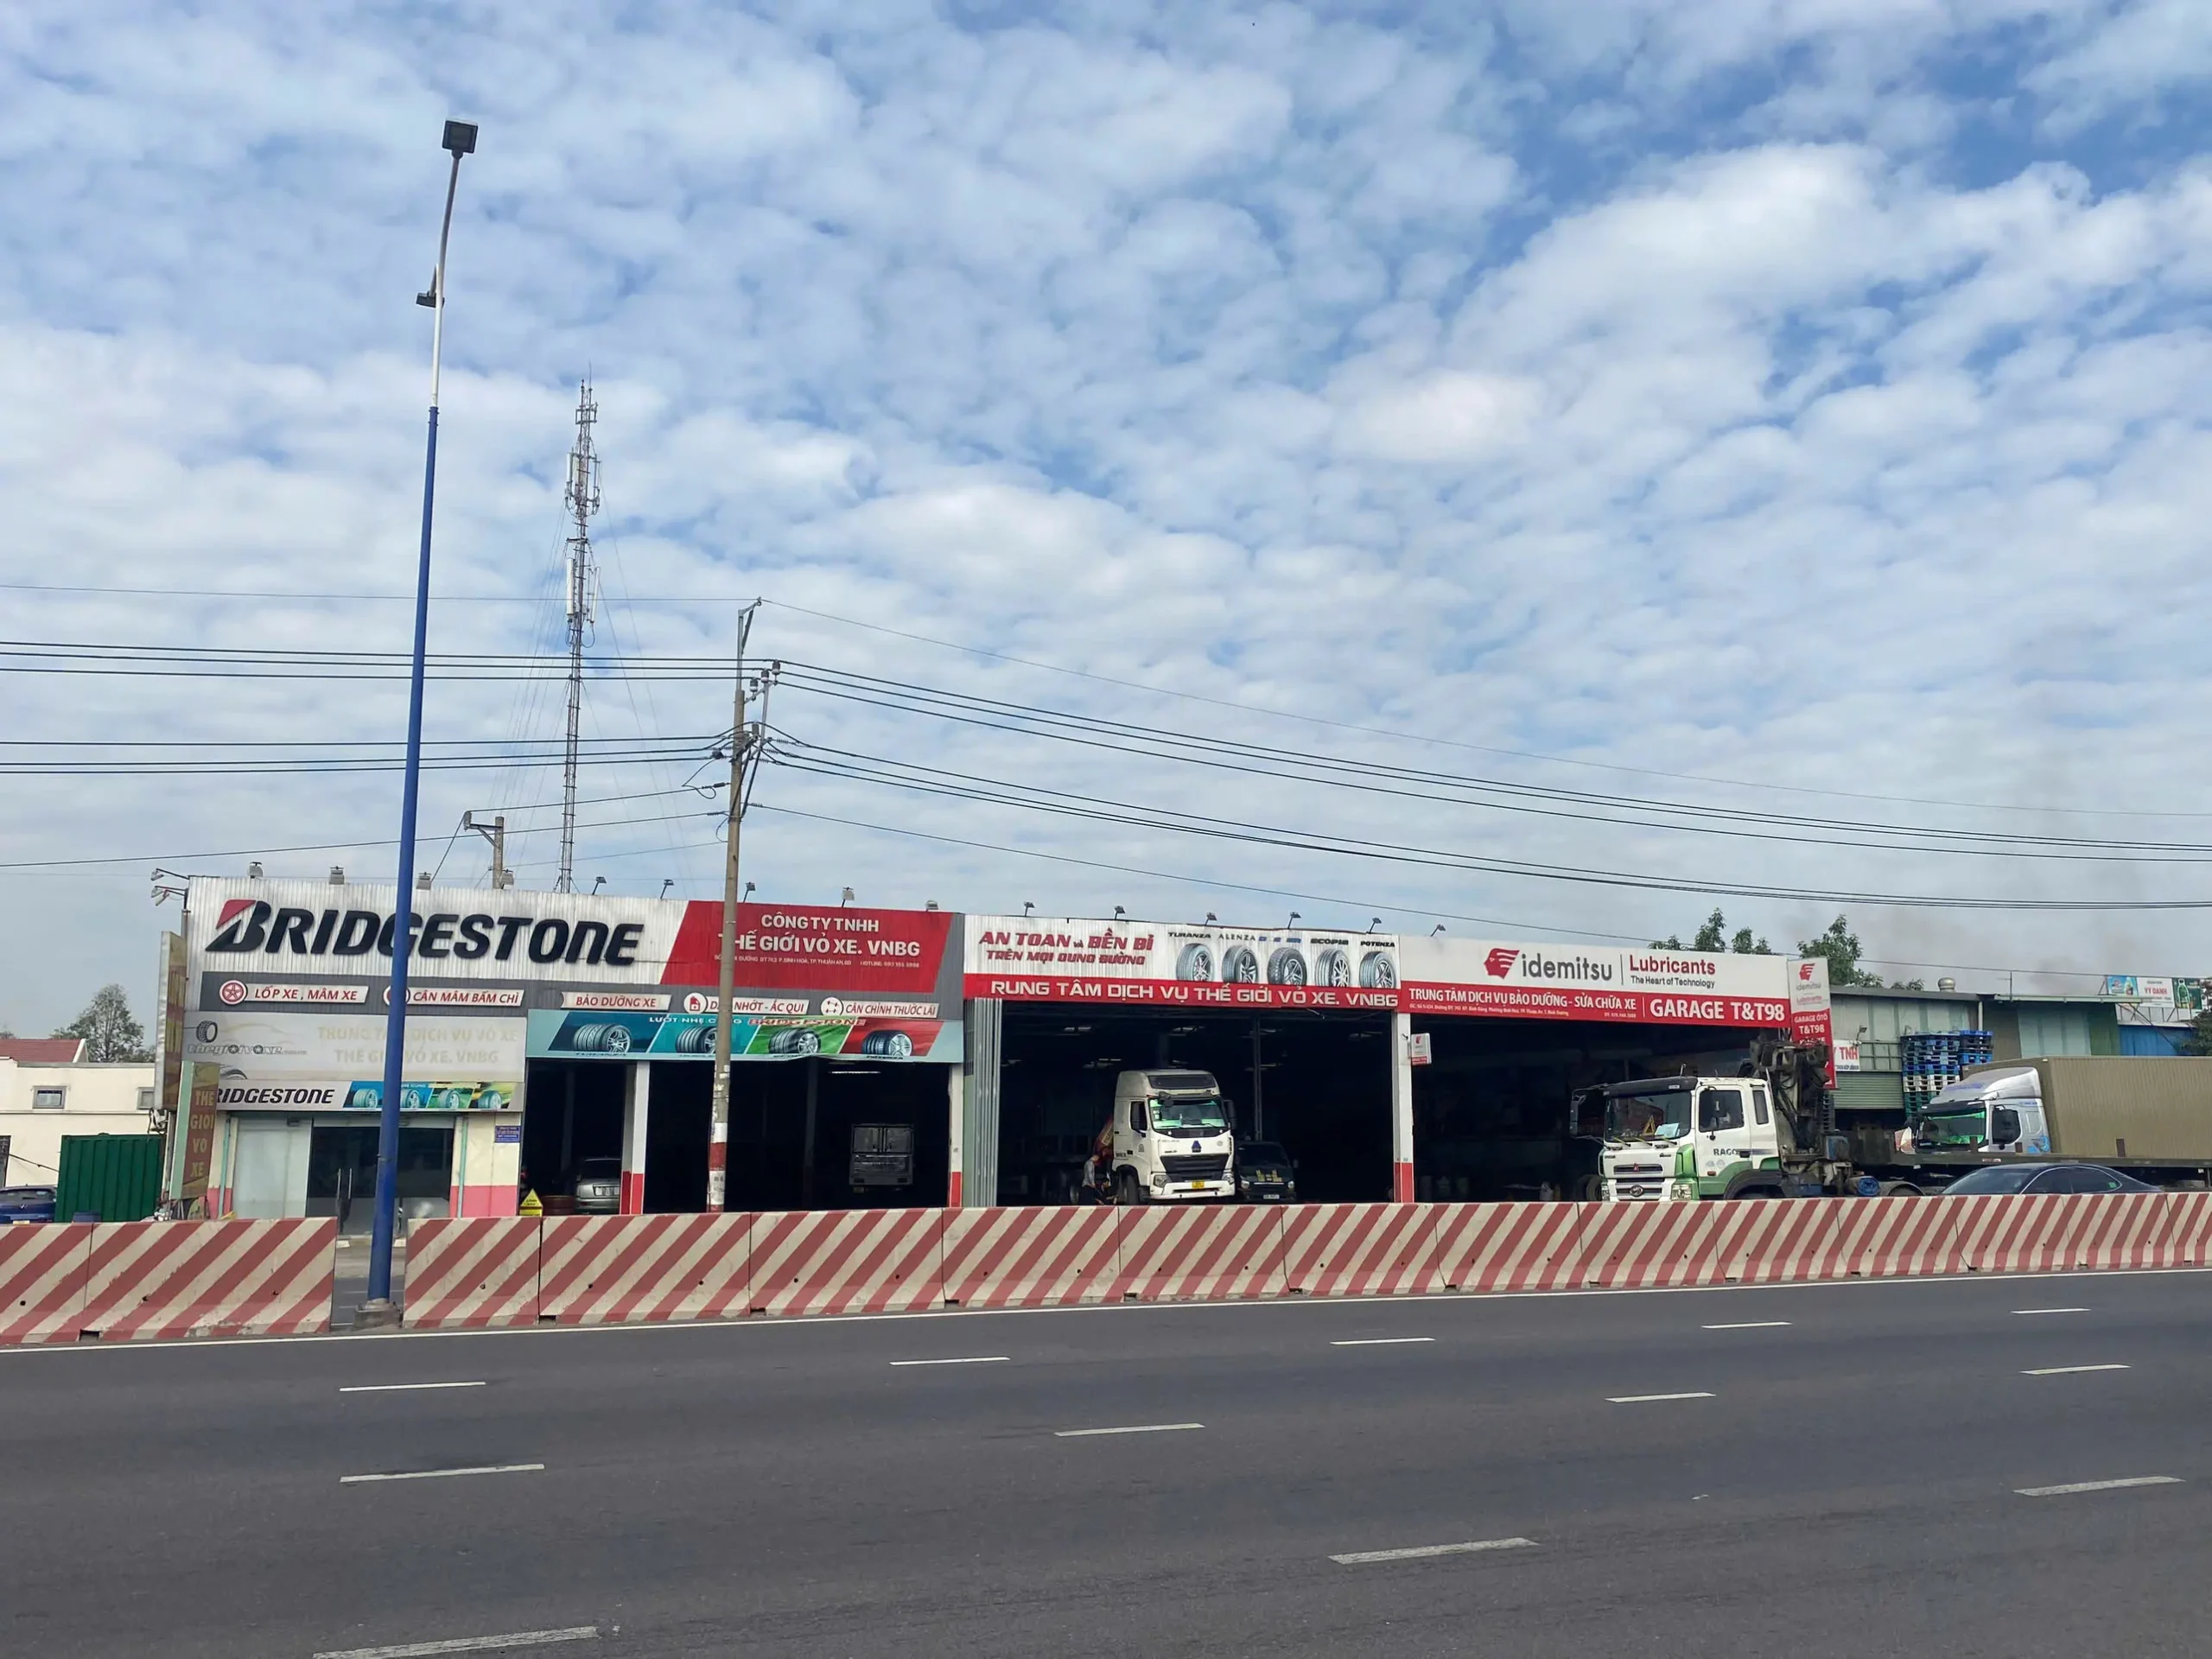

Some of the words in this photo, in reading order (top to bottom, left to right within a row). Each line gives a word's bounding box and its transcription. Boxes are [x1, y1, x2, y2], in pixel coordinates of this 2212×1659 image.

[761, 912, 809, 929] CÔNG
[810, 917, 831, 931] TY
[834, 918, 880, 932] TNHH
[206, 899, 644, 966] BRIDGESTONE
[979, 931, 1011, 945] AN
[760, 931, 800, 952] GIỚI
[803, 932, 830, 953] VỎ
[833, 938, 862, 955] XE.
[868, 940, 921, 957] VNBG
[1522, 952, 1612, 981] idemitsu
[1630, 954, 1716, 975] Lubricants
[1630, 976, 1644, 984] The
[1645, 976, 1666, 985] Heart
[1675, 978, 1715, 988] Technology
[255, 985, 281, 999] LỐP
[282, 988, 299, 1000] XE
[308, 988, 340, 1001] MÂM
[340, 990, 359, 1001] XE
[413, 989, 438, 1001] CÂN
[440, 991, 469, 1003] MÂM
[471, 990, 497, 1003] BẤM
[575, 994, 598, 1006] BẢO
[601, 995, 640, 1007] DƯỠNG
[642, 998, 657, 1007] XE
[991, 980, 1050, 995] RUNG
[1056, 979, 1102, 996] TÂM
[1108, 984, 1154, 1001] DỊCH
[1160, 986, 1189, 1002] VỤ
[1194, 983, 1231, 1001] THẾ
[1237, 985, 1273, 1002] GIỚI
[1277, 986, 1306, 1004] VỎ
[1345, 993, 1399, 1007] VNBG
[1408, 988, 1444, 1001] TRUNG
[1444, 987, 1467, 1002] TÂM
[1468, 990, 1492, 1006] DỊCH
[1493, 992, 1508, 1007] VỤ
[1509, 989, 1530, 1005] BẢO
[1531, 992, 1567, 1007] DƯỠNG
[1574, 992, 1594, 1007] SỬA
[1595, 995, 1623, 1009] CHỮA
[1624, 998, 1637, 1010] XE
[734, 999, 764, 1011] NHỚT
[785, 1003, 804, 1014] QUI
[845, 1003, 863, 1014] CÂN
[864, 1002, 892, 1014] CHỈNH
[893, 1002, 923, 1016] THƯỚC
[924, 1003, 936, 1016] LÁI
[1649, 999, 1725, 1020] GARAGE
[1730, 1001, 1785, 1021] T&T98
[1799, 1024, 1825, 1035] T&T98
[217, 1088, 335, 1104] RIDGESTONE
[191, 1161, 206, 1177] XE
